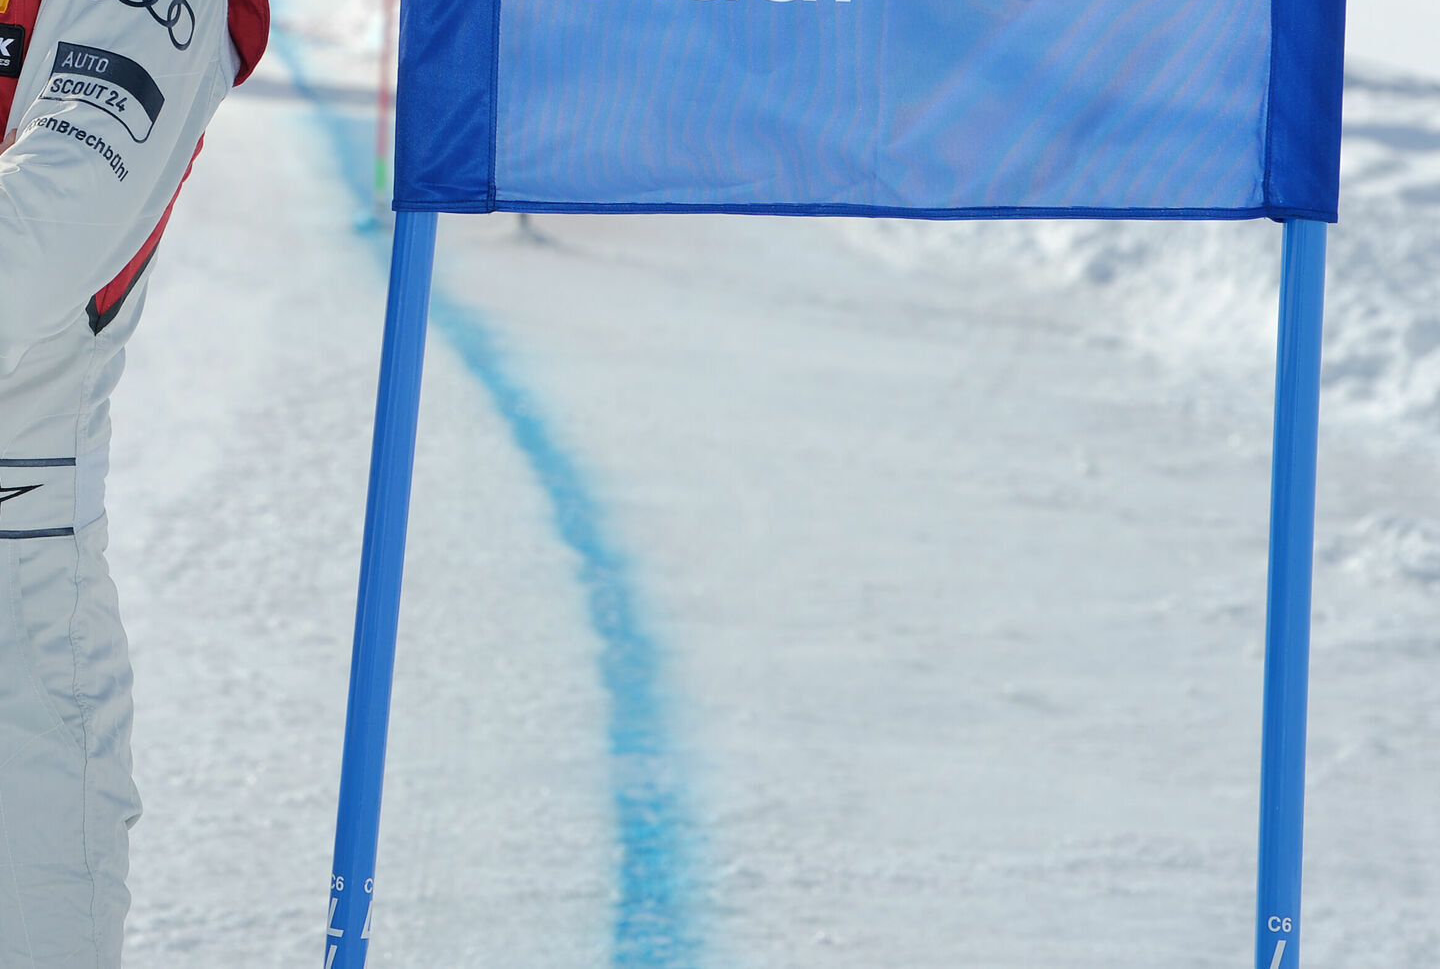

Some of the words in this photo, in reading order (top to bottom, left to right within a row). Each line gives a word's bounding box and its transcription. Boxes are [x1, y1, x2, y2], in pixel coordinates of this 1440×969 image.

[61, 50, 110, 73] AUTO
[50, 78, 109, 100] SCOUT
[105, 90, 129, 113] 24
[1268, 916, 1292, 933] C6
